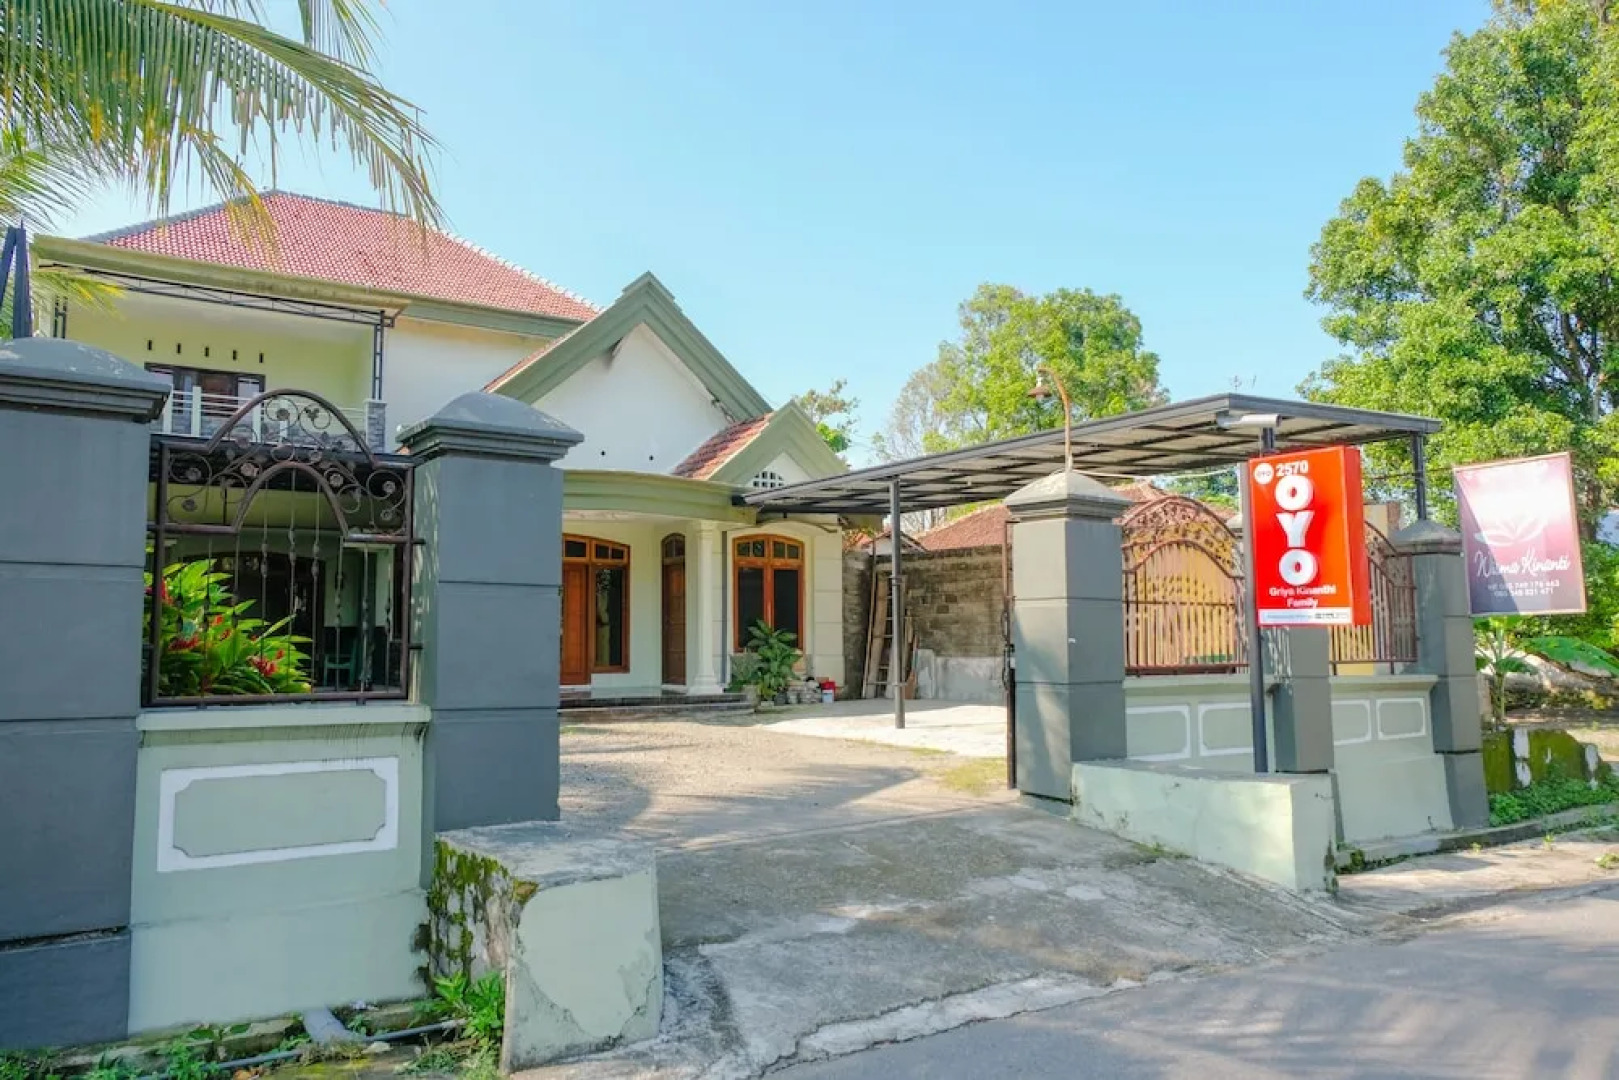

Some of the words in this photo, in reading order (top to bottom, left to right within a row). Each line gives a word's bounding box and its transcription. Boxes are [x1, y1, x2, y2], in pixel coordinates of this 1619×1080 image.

[1276, 460, 1309, 477] 2570
[1274, 475, 1318, 586] OYO
[1287, 598, 1318, 609] Family
